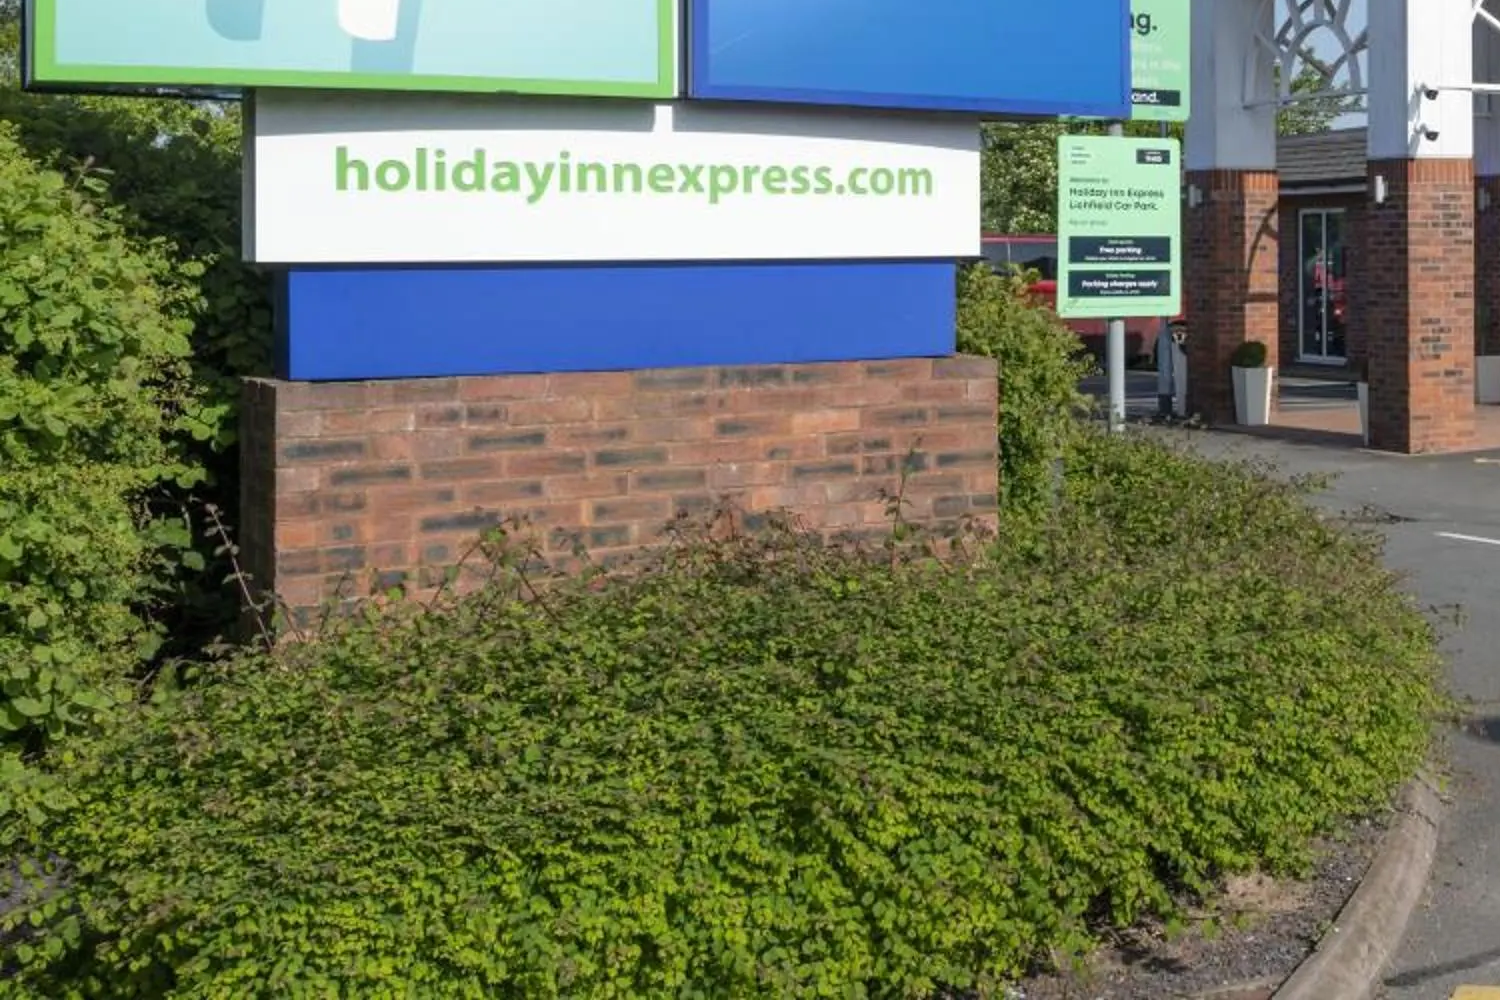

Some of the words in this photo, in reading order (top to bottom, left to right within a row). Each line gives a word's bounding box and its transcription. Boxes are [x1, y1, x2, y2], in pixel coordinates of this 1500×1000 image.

[334, 147, 934, 204] holidayinnexpress.com
[1069, 187, 1107, 199] Holiday
[1127, 188, 1164, 199] Express
